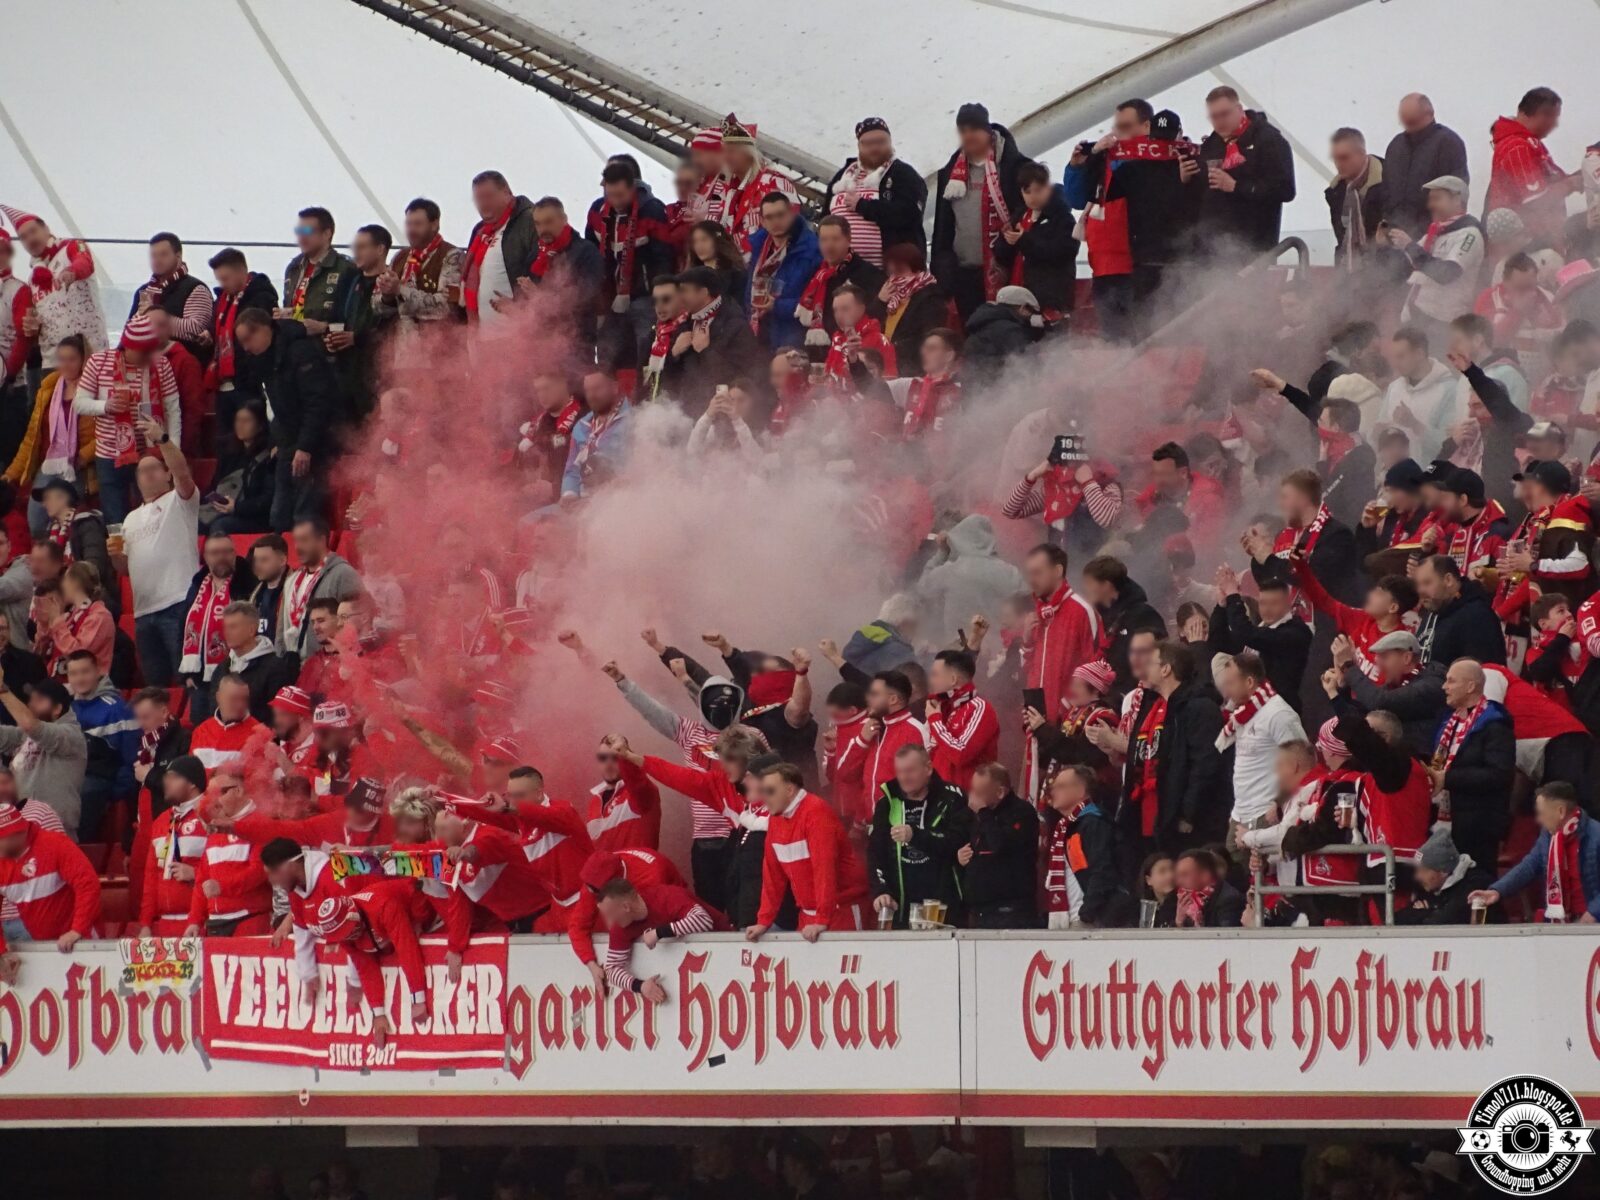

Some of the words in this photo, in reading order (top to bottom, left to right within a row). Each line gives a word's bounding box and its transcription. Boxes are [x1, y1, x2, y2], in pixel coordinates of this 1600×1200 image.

[1137, 143, 1161, 157] FC
[1023, 950, 1280, 1080] Stuttgarter
[1291, 947, 1487, 1072] Hofbräu
[329, 1043, 363, 1066] SINCE
[366, 1043, 397, 1066] 2017
